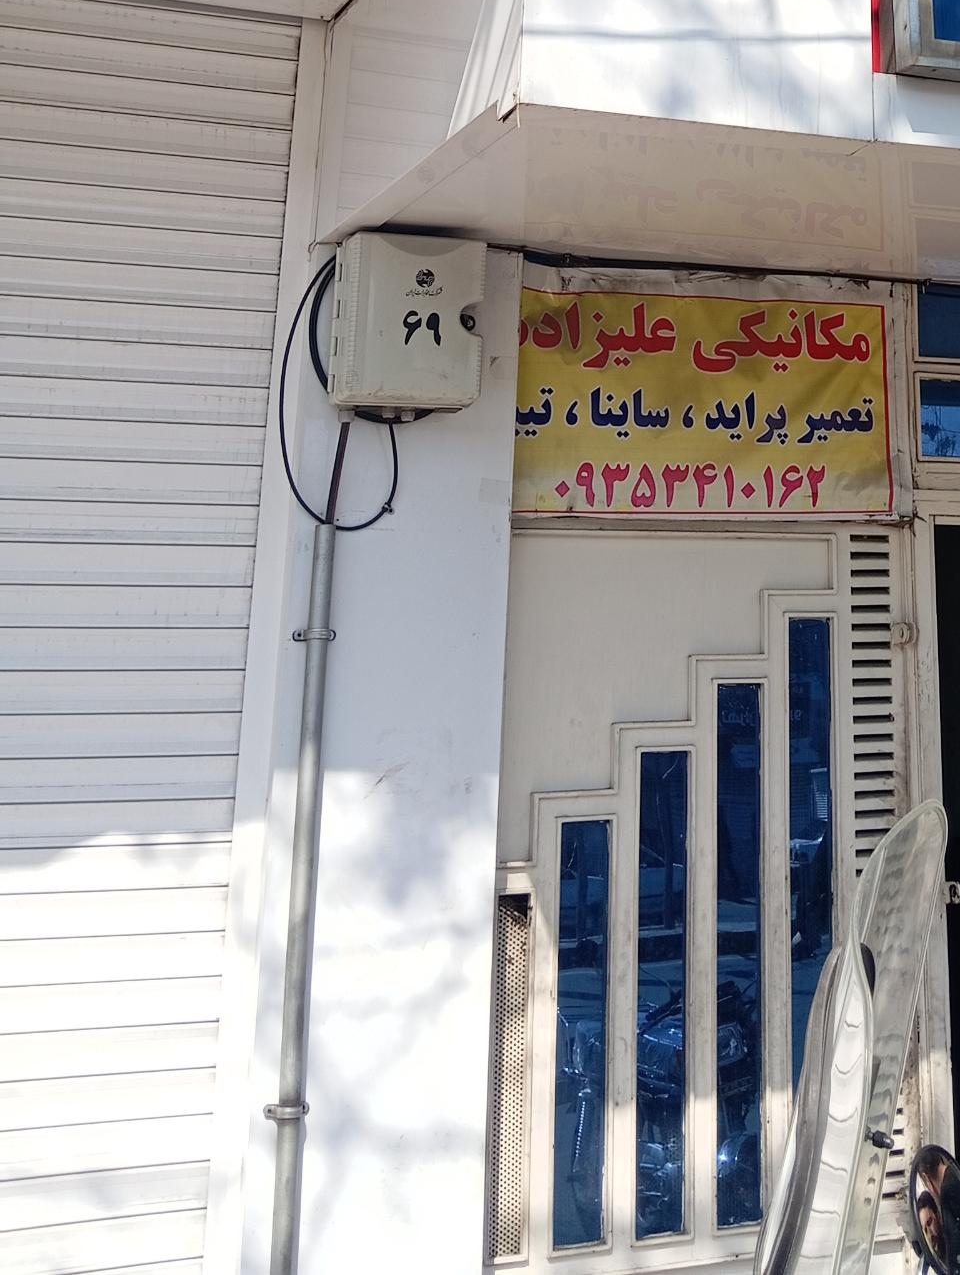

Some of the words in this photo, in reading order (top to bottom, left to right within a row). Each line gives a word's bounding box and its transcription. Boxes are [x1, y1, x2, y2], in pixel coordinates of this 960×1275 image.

[403, 310, 441, 346] ۶۹
[692, 309, 870, 373] مکانیکی
[797, 397, 874, 444] تعمیر
[554, 463, 826, 508] ۰۹۳۵۳۴۱۰۱۶۲
